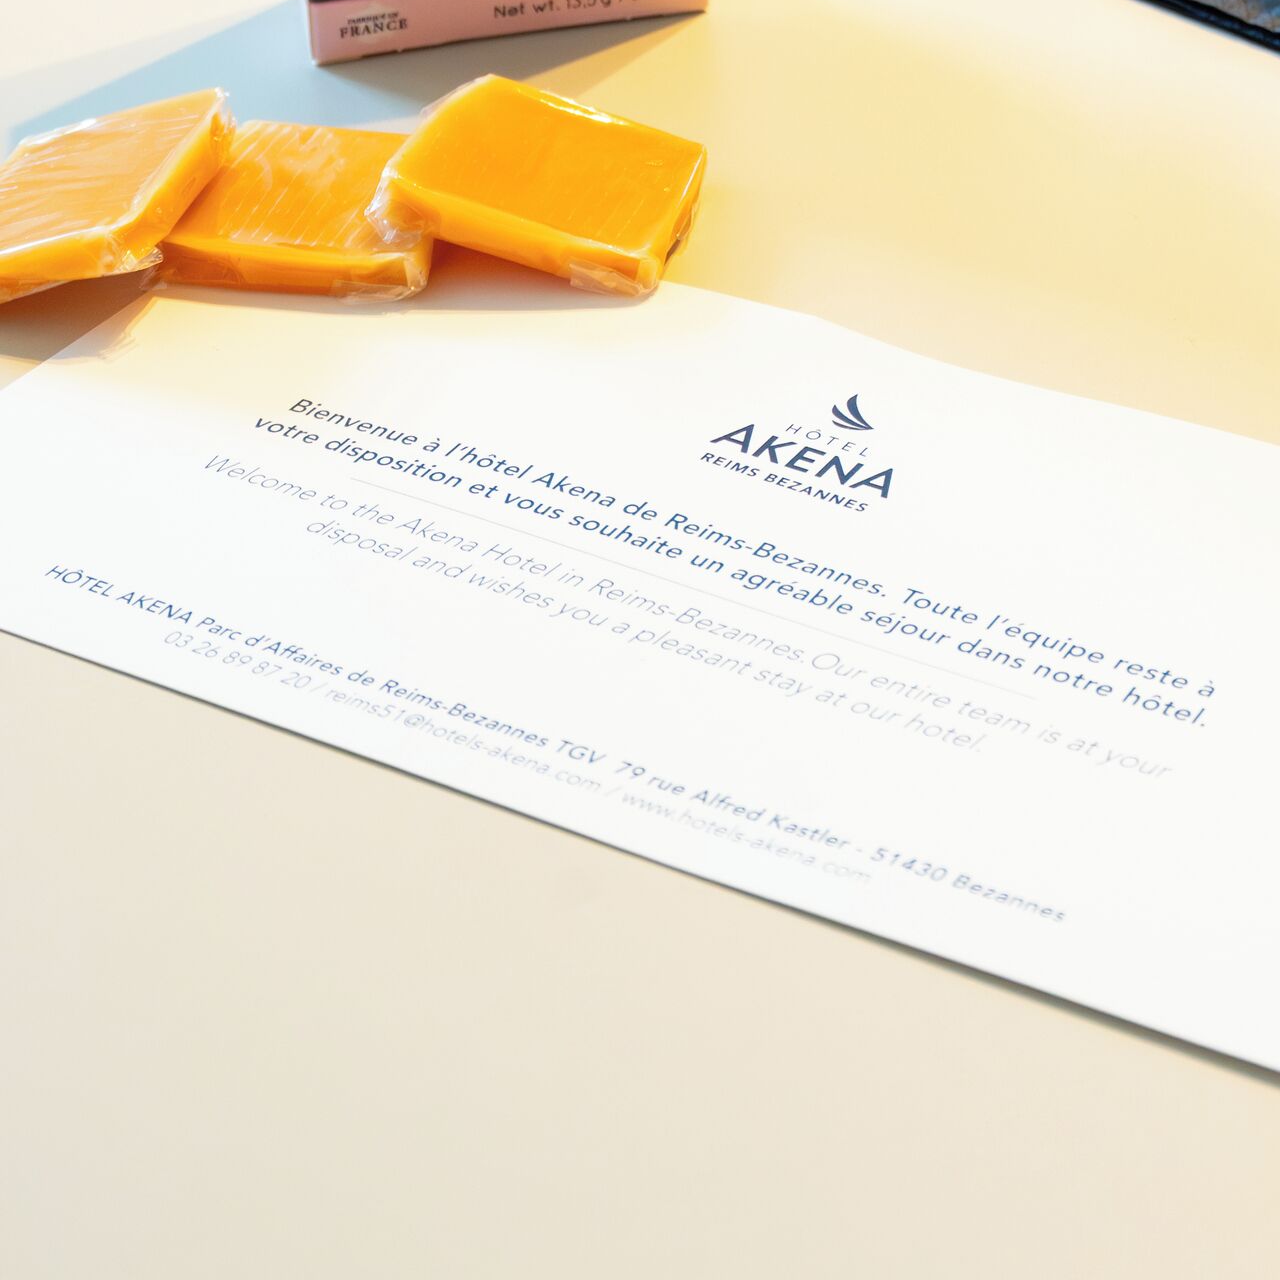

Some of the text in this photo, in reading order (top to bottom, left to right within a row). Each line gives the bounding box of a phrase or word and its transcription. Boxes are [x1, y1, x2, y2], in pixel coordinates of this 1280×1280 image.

[339, 18, 408, 39] FRANCE
[493, 2, 525, 19] Net
[532, 0, 561, 14] wt.
[709, 423, 894, 500] AKENA
[785, 423, 872, 458] HÔTEL
[700, 452, 869, 513] REIMS BEZANNES
[254, 417, 1208, 728] votre disposition et vous souhaite un agréable séjour dans notre hôtel.
[289, 398, 1216, 697] Bienvenue à l'hôtel Akena de Reims-Bezannes. Toute l'équipe reste à
[204, 455, 1175, 780] Welcome to the Akena Hotel in Reims-Bezannes. Our entire team is at your
[306, 519, 989, 753] disposal and wishes you a pleasant stay at our hotel.
[163, 631, 194, 650] 03
[192, 641, 219, 659] 26
[222, 650, 253, 668] 89
[251, 660, 283, 679] 87
[280, 671, 313, 690] 20
[45, 564, 115, 598] HÔTEL
[116, 591, 194, 625] AKENA
[196, 616, 242, 641] Parc
[244, 633, 343, 677] d'Affaires
[348, 669, 376, 688] de
[379, 679, 550, 749] Reims-Bezannes
[556, 740, 608, 766] TGV
[614, 760, 647, 781] 79
[649, 775, 687, 796] rue
[690, 789, 768, 823] Alfred
[768, 813, 852, 849] Kastler
[869, 845, 950, 882] 51430
[952, 873, 1067, 924] Bezannes
